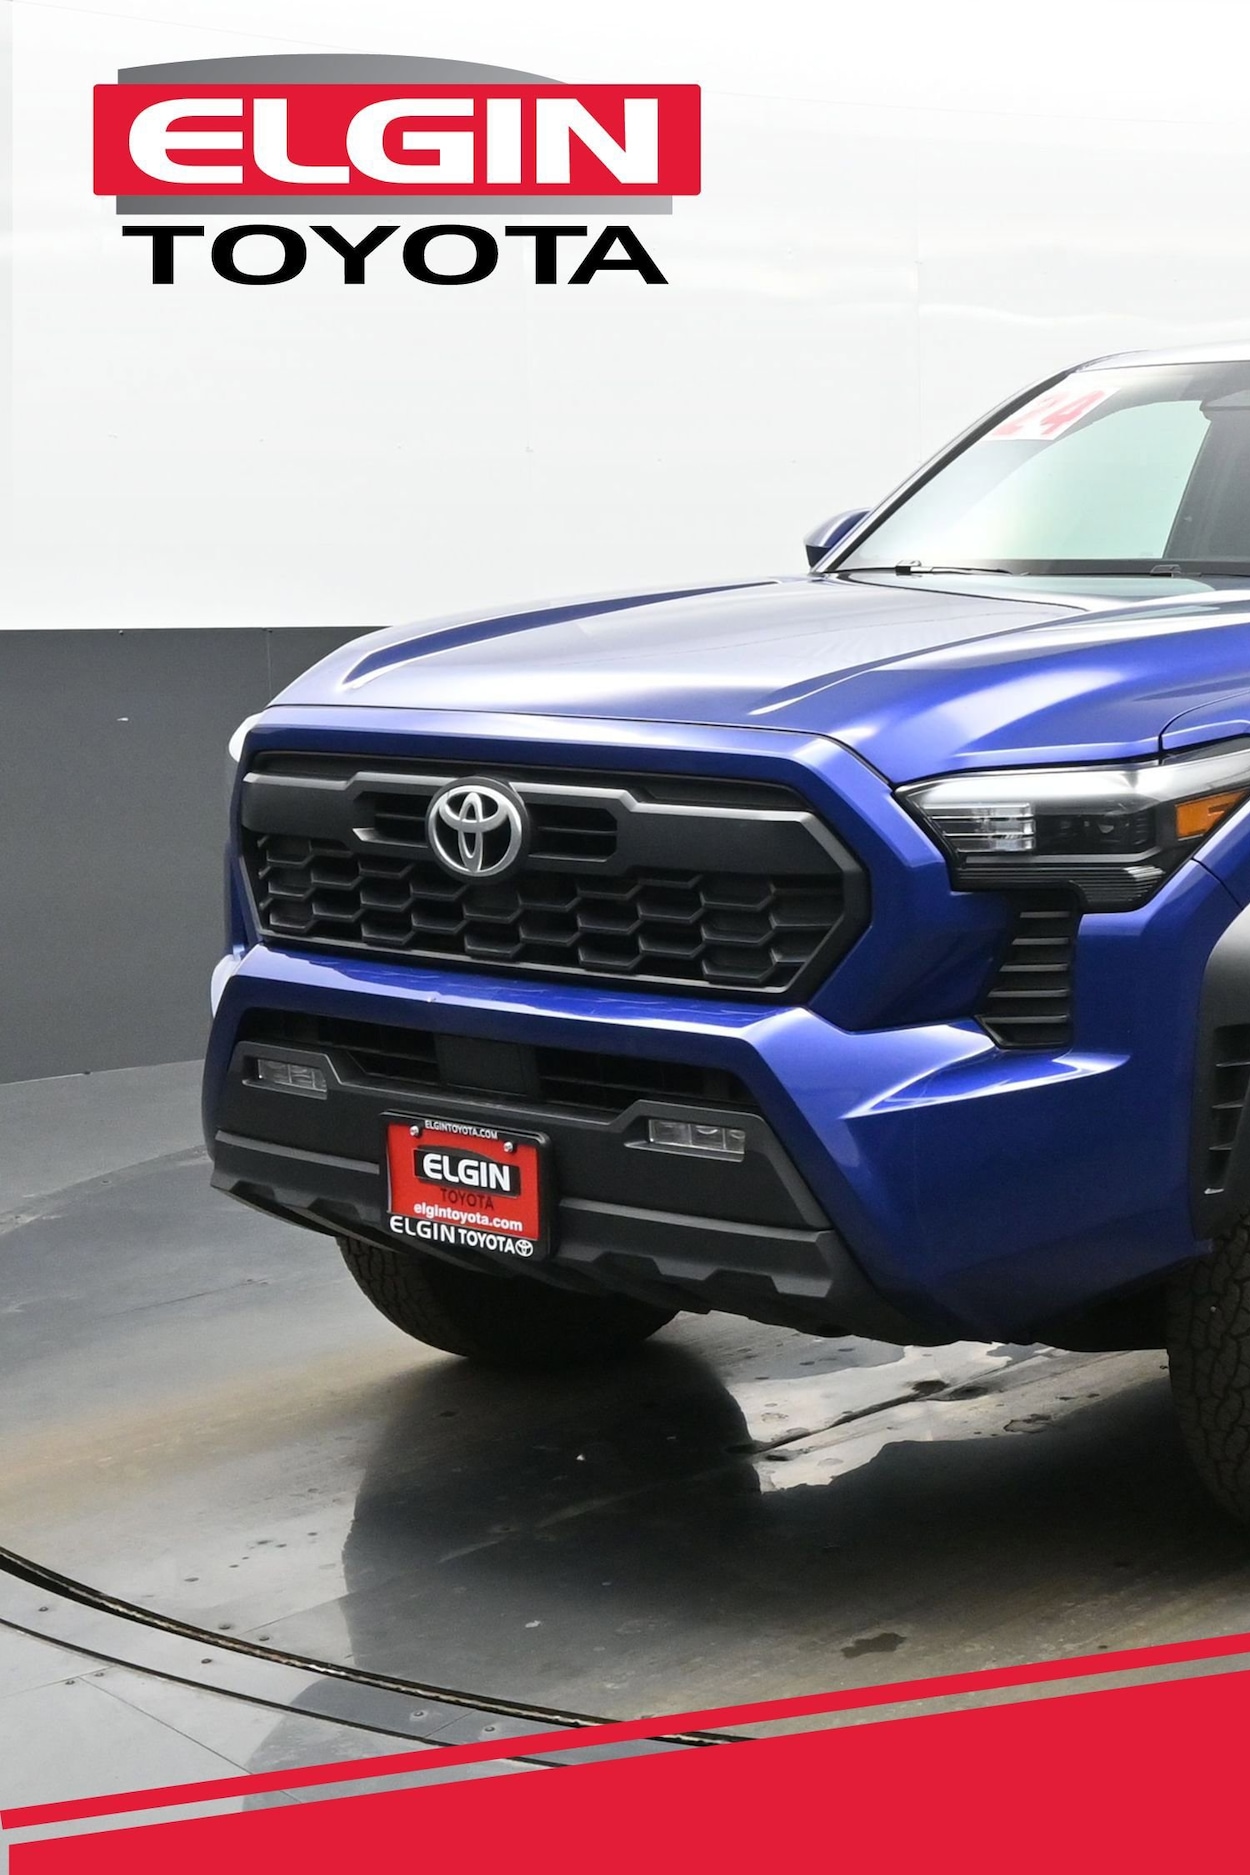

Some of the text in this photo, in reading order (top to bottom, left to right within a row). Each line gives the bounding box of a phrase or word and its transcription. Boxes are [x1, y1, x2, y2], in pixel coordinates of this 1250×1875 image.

[424, 1119, 498, 1140] ELGINTOYOTA.COM
[422, 1152, 511, 1191] ELGIN
[440, 1187, 494, 1211] TOYOTA
[413, 1202, 523, 1232] elgintoyota.com
[389, 1215, 516, 1254] ELGIN TOYOTA
